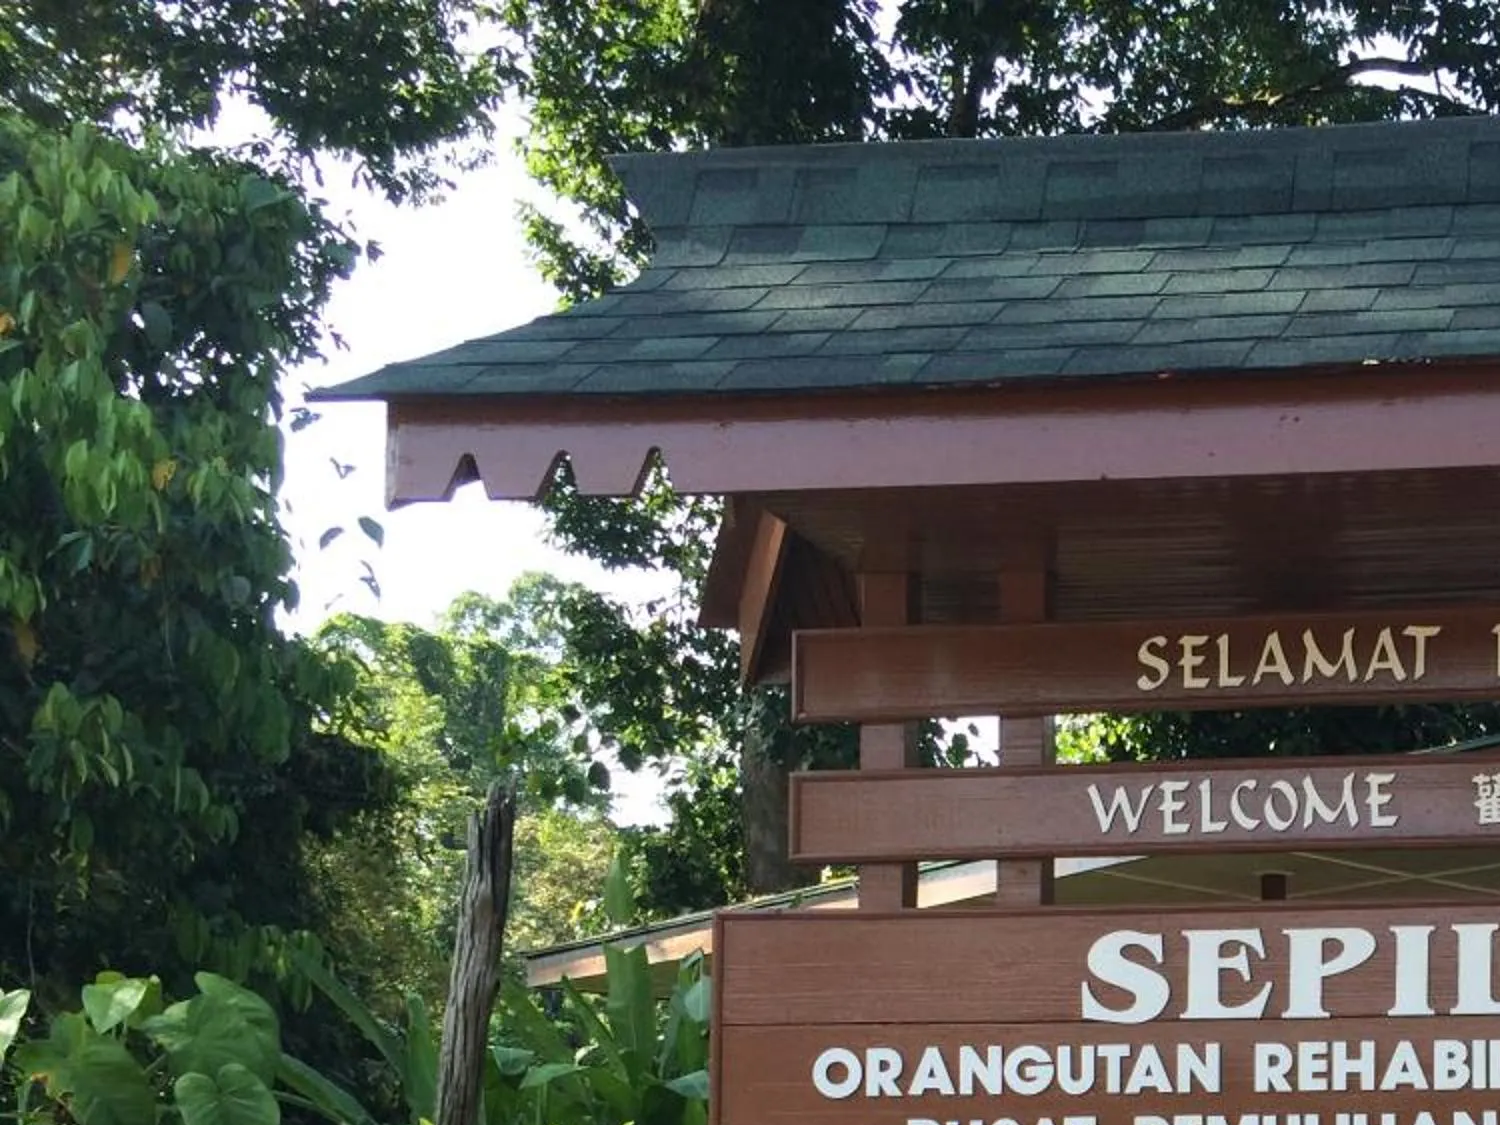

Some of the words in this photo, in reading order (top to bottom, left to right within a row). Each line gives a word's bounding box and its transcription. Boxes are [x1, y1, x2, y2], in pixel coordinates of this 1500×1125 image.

[1136, 625, 1441, 691] SELAMAT
[1086, 772, 1400, 835] WELCOME
[811, 1041, 1221, 1099] ORANGUTAN
